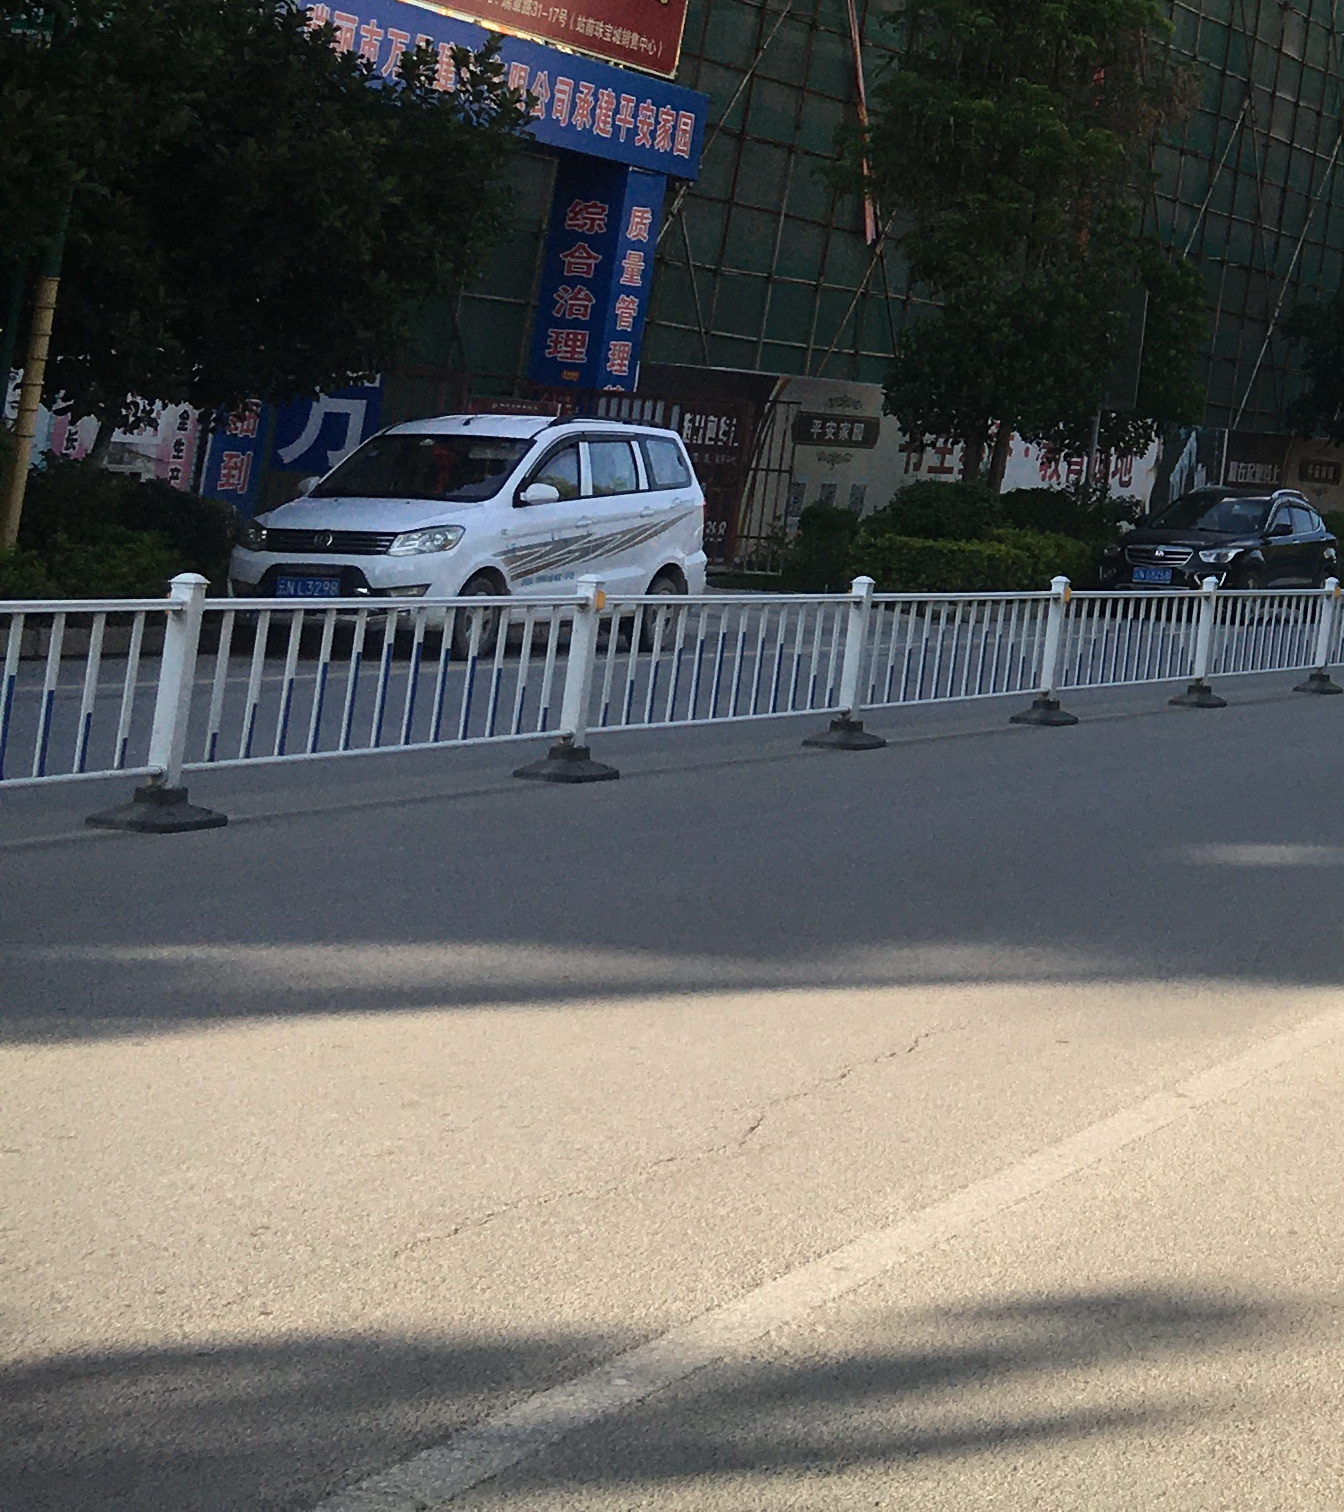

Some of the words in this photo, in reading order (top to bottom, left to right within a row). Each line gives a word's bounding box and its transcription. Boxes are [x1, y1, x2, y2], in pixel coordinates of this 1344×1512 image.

[545, 198, 609, 364] 综合治理
[603, 205, 653, 392] 质量管理
[809, 418, 865, 442] 平安家园
